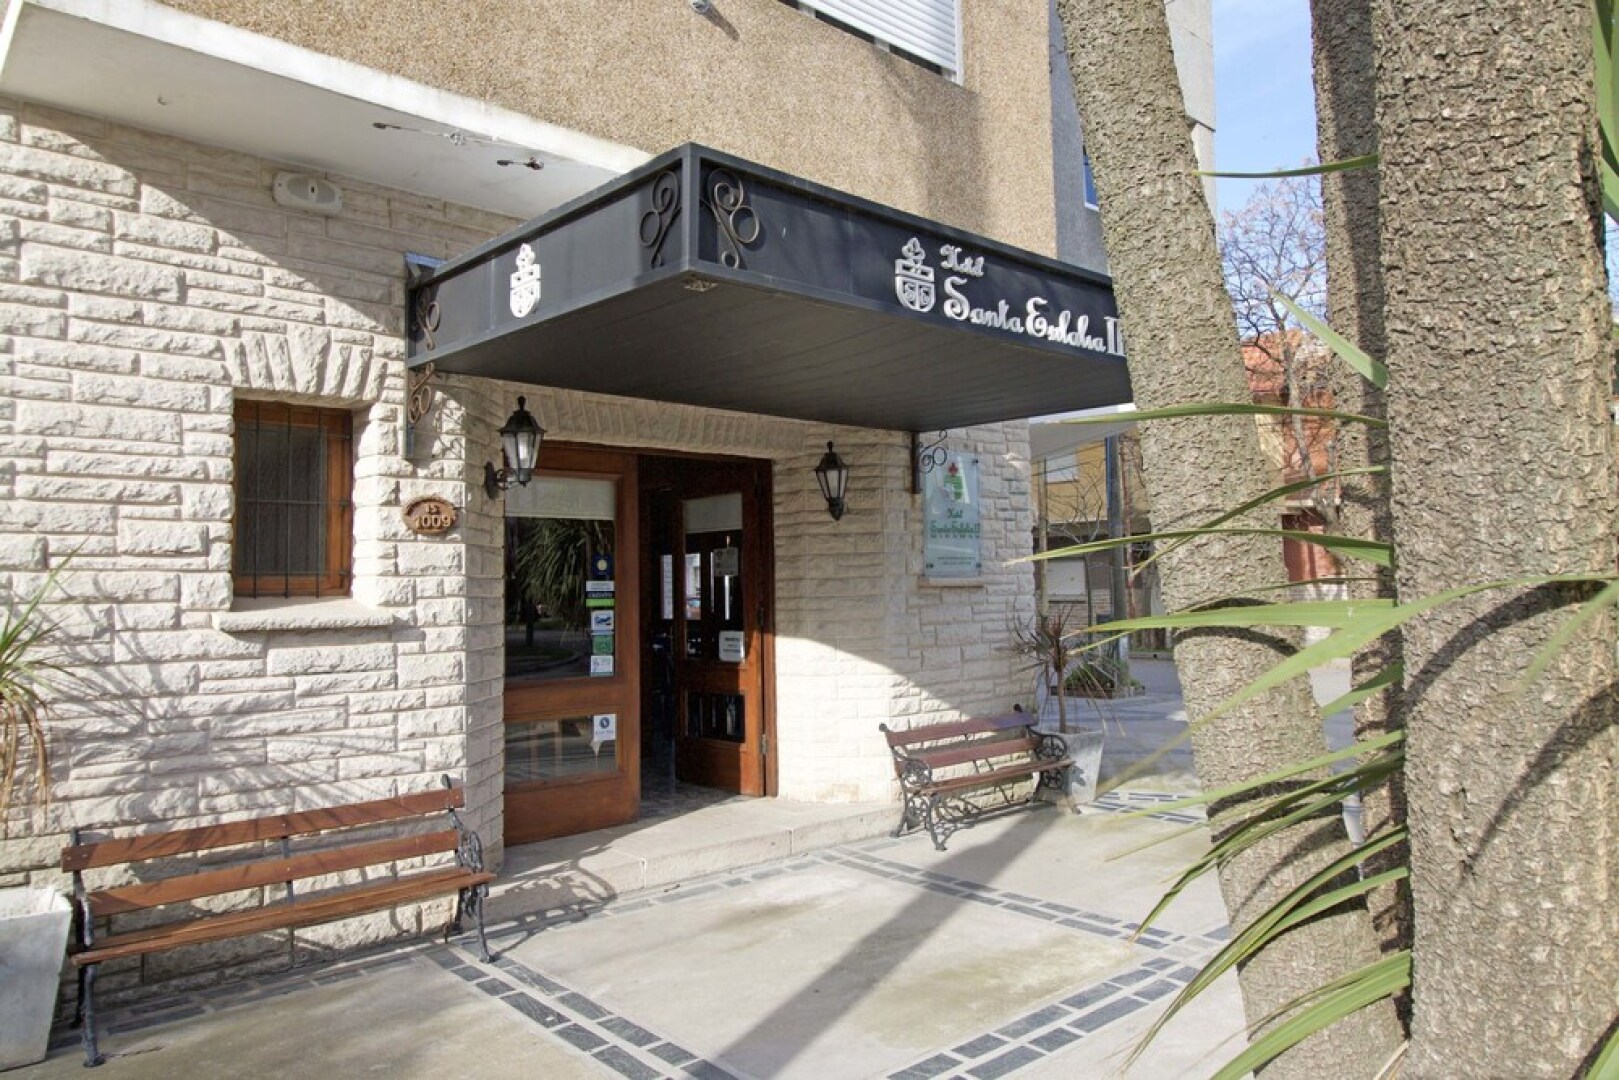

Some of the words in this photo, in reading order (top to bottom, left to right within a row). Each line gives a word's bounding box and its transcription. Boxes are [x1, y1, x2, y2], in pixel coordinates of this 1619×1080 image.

[940, 244, 985, 276] Hotel
[943, 276, 1024, 334] Santa
[1025, 296, 1107, 352] Eulalia
[415, 514, 451, 528] 1009
